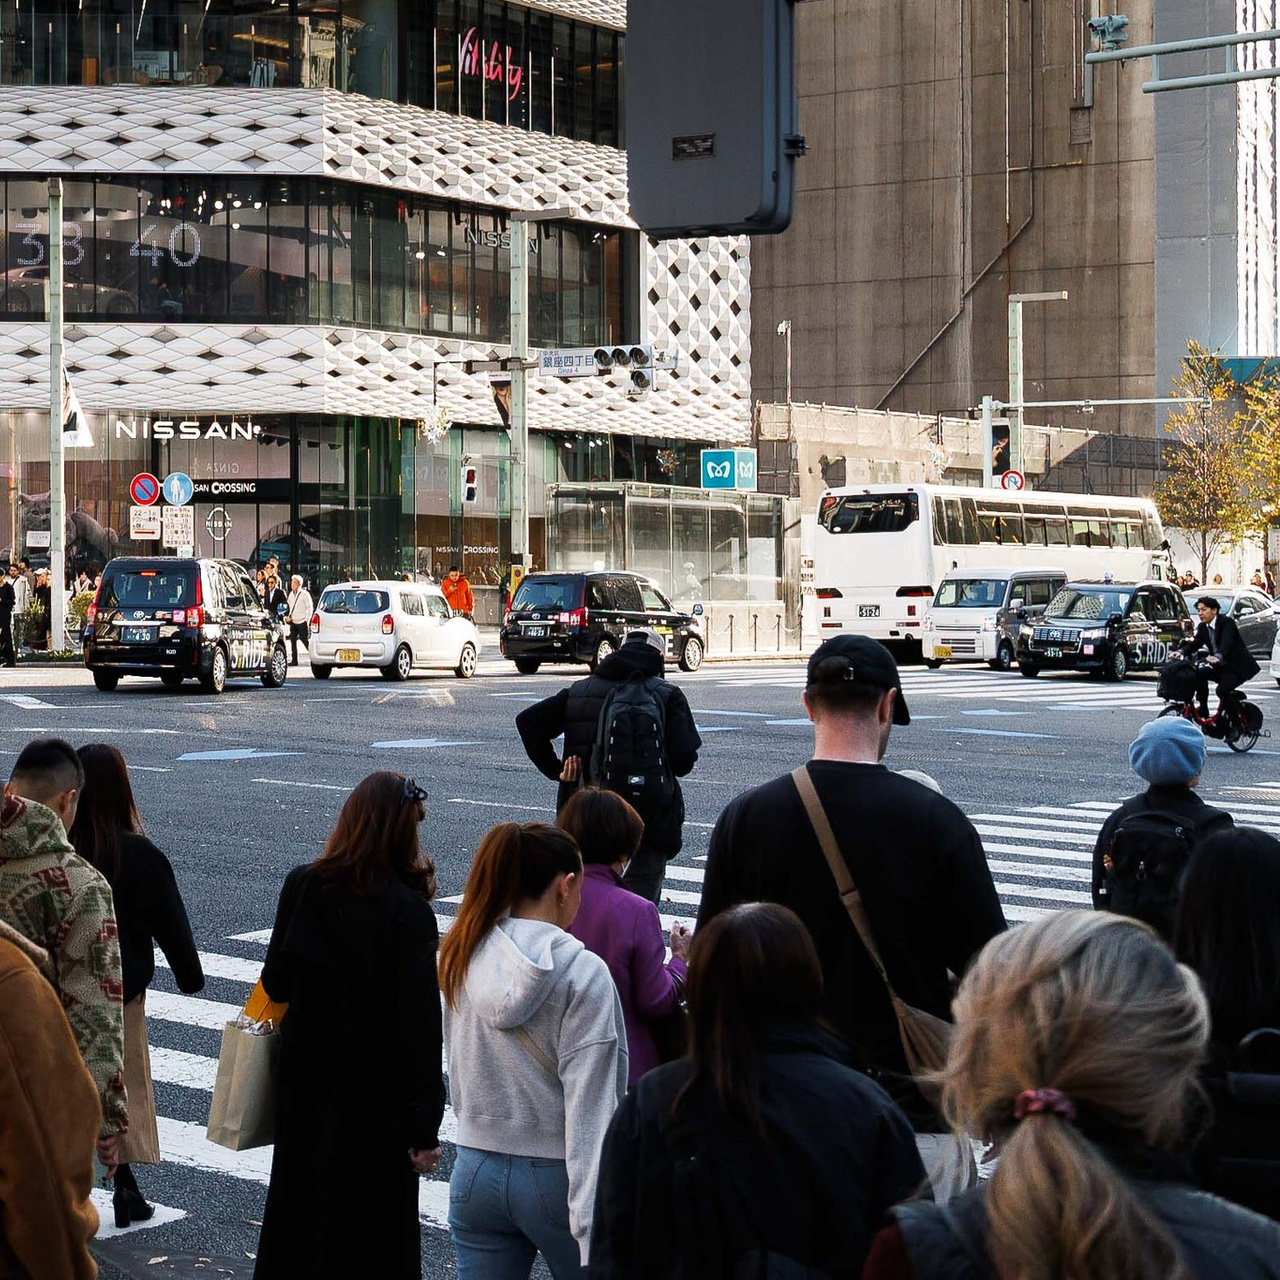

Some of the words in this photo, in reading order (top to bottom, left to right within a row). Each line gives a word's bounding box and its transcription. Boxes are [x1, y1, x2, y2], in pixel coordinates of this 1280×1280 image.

[467, 227, 539, 254] NISSN
[542, 355, 594, 368] 銀座四丁目
[115, 420, 253, 441] NISSAN
[211, 481, 256, 495] CROSSING
[463, 545, 499, 554] CROSSING
